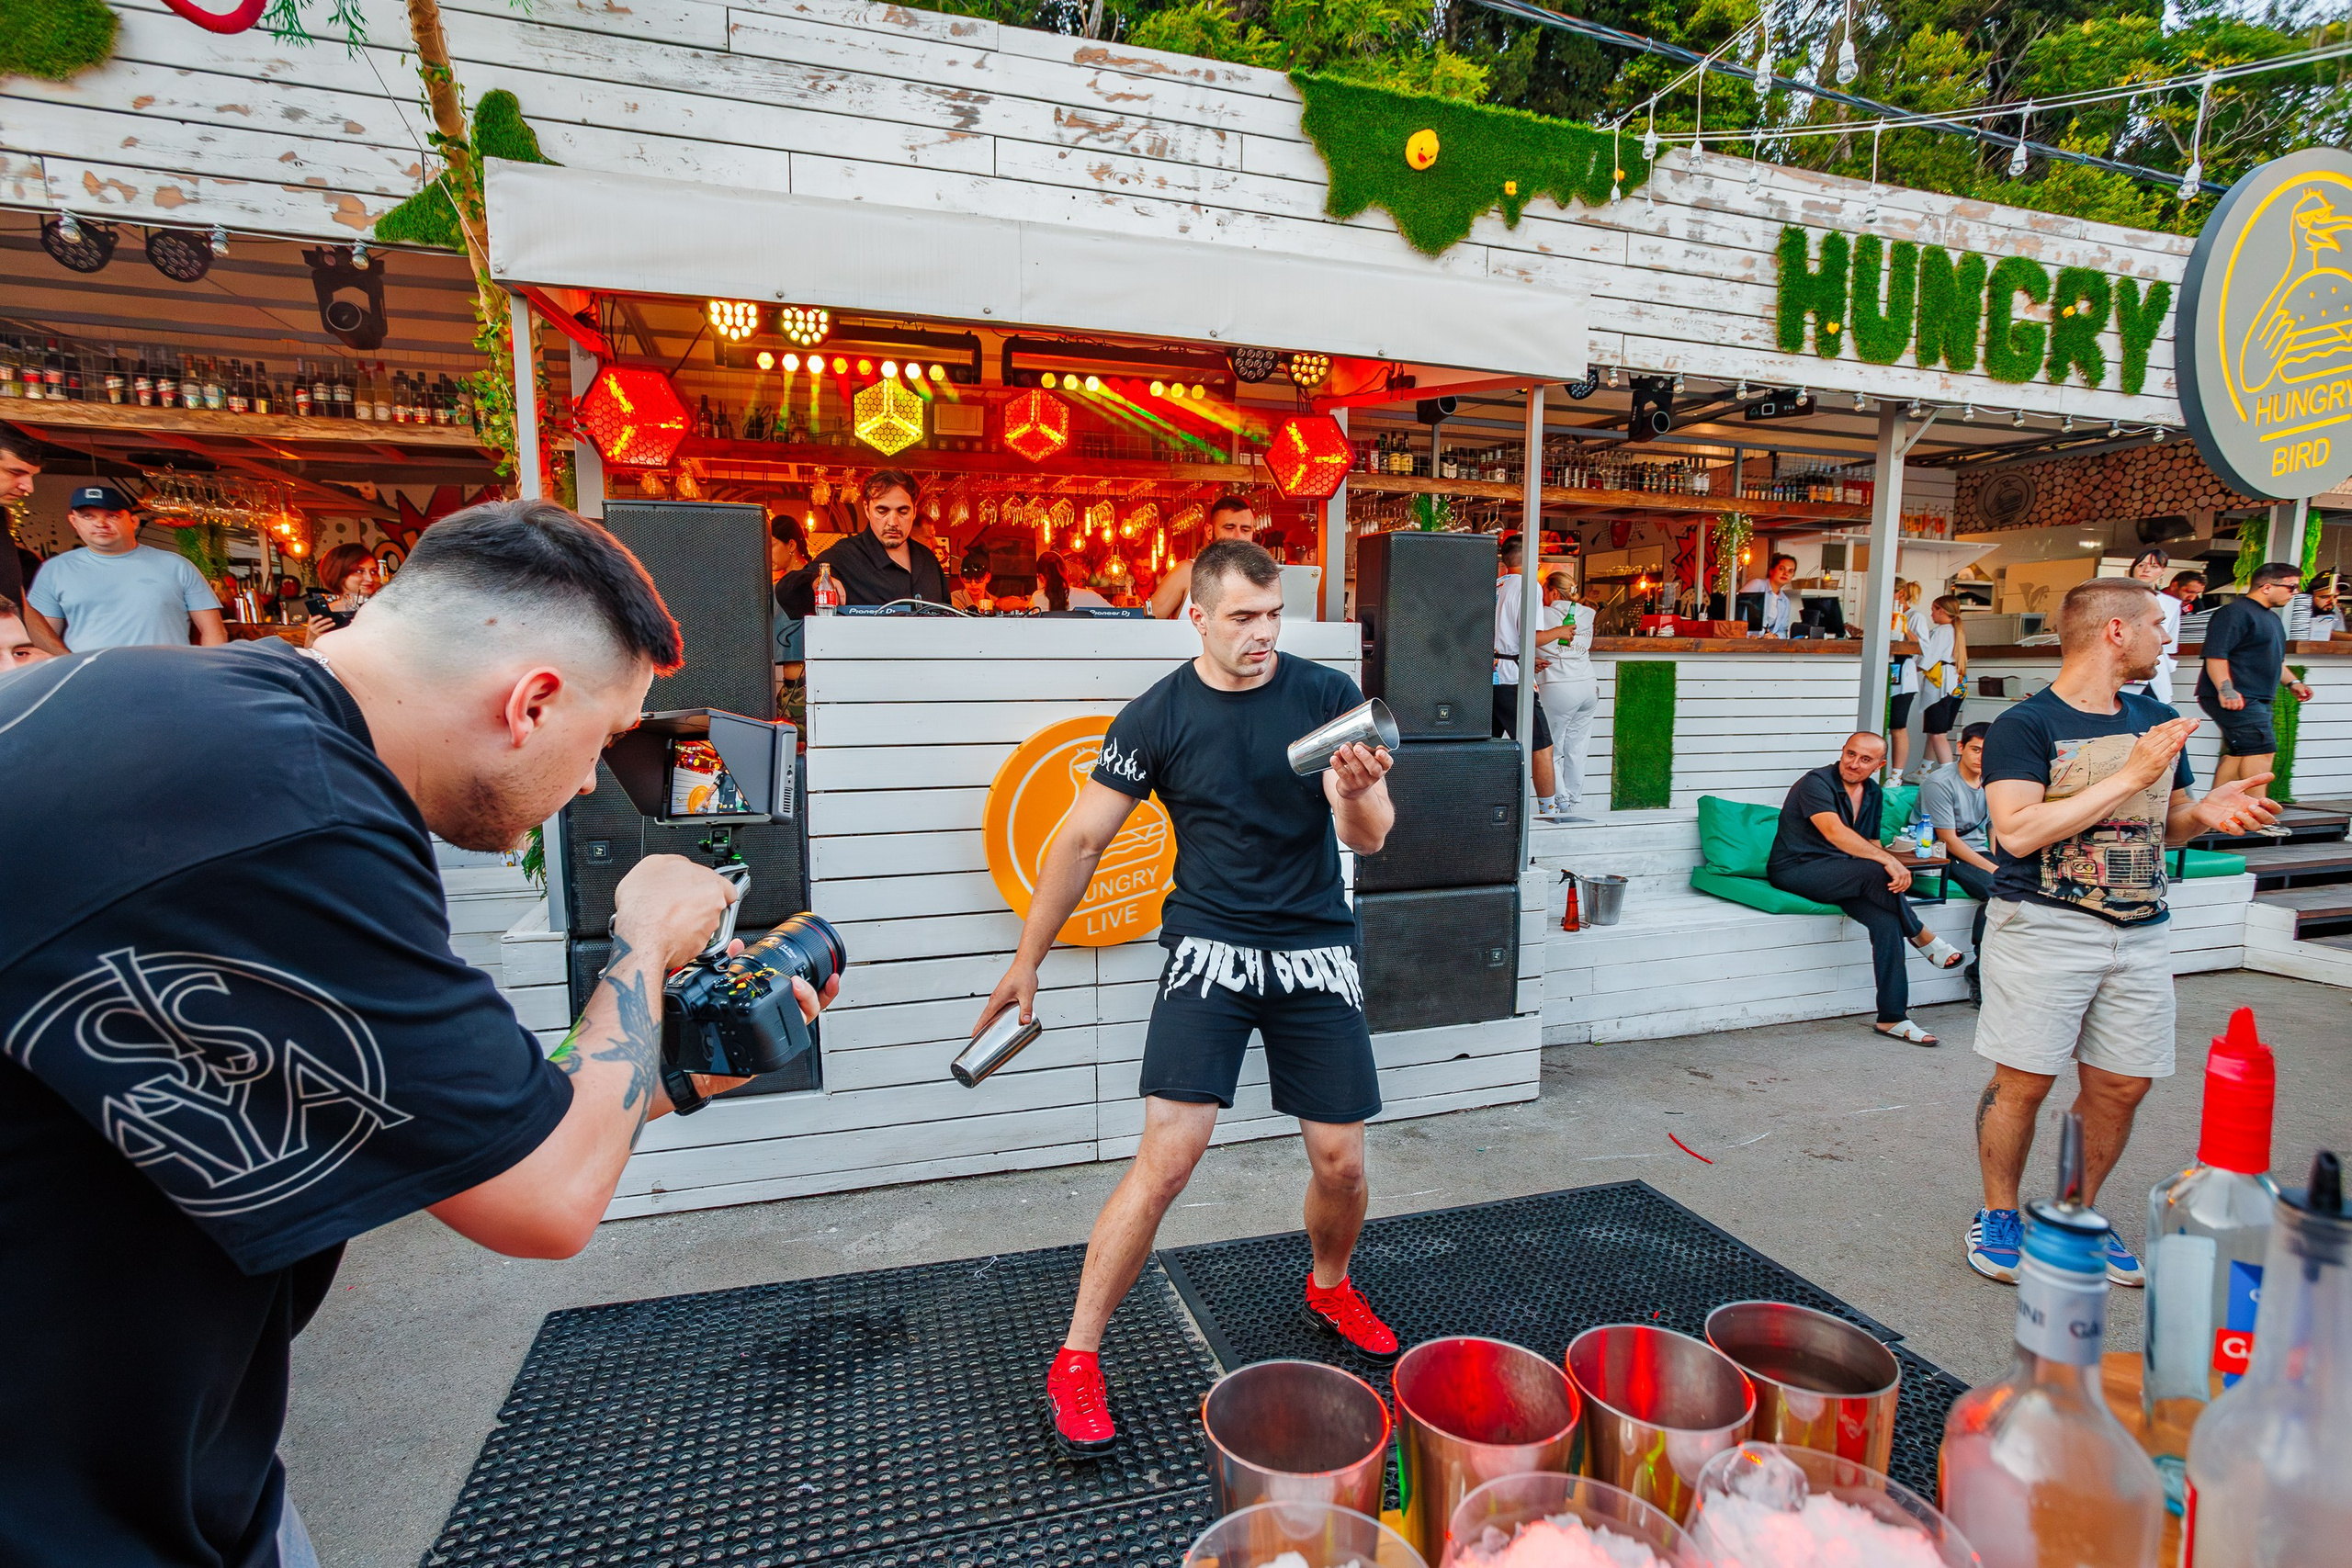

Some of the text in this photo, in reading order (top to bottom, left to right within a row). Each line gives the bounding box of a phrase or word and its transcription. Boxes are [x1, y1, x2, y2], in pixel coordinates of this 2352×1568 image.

[1776, 222, 2172, 396] HUNGRY
[2271, 436, 2331, 477] BIRD
[1082, 864, 1159, 903] UNGRY
[1087, 903, 1139, 936] LIVE
